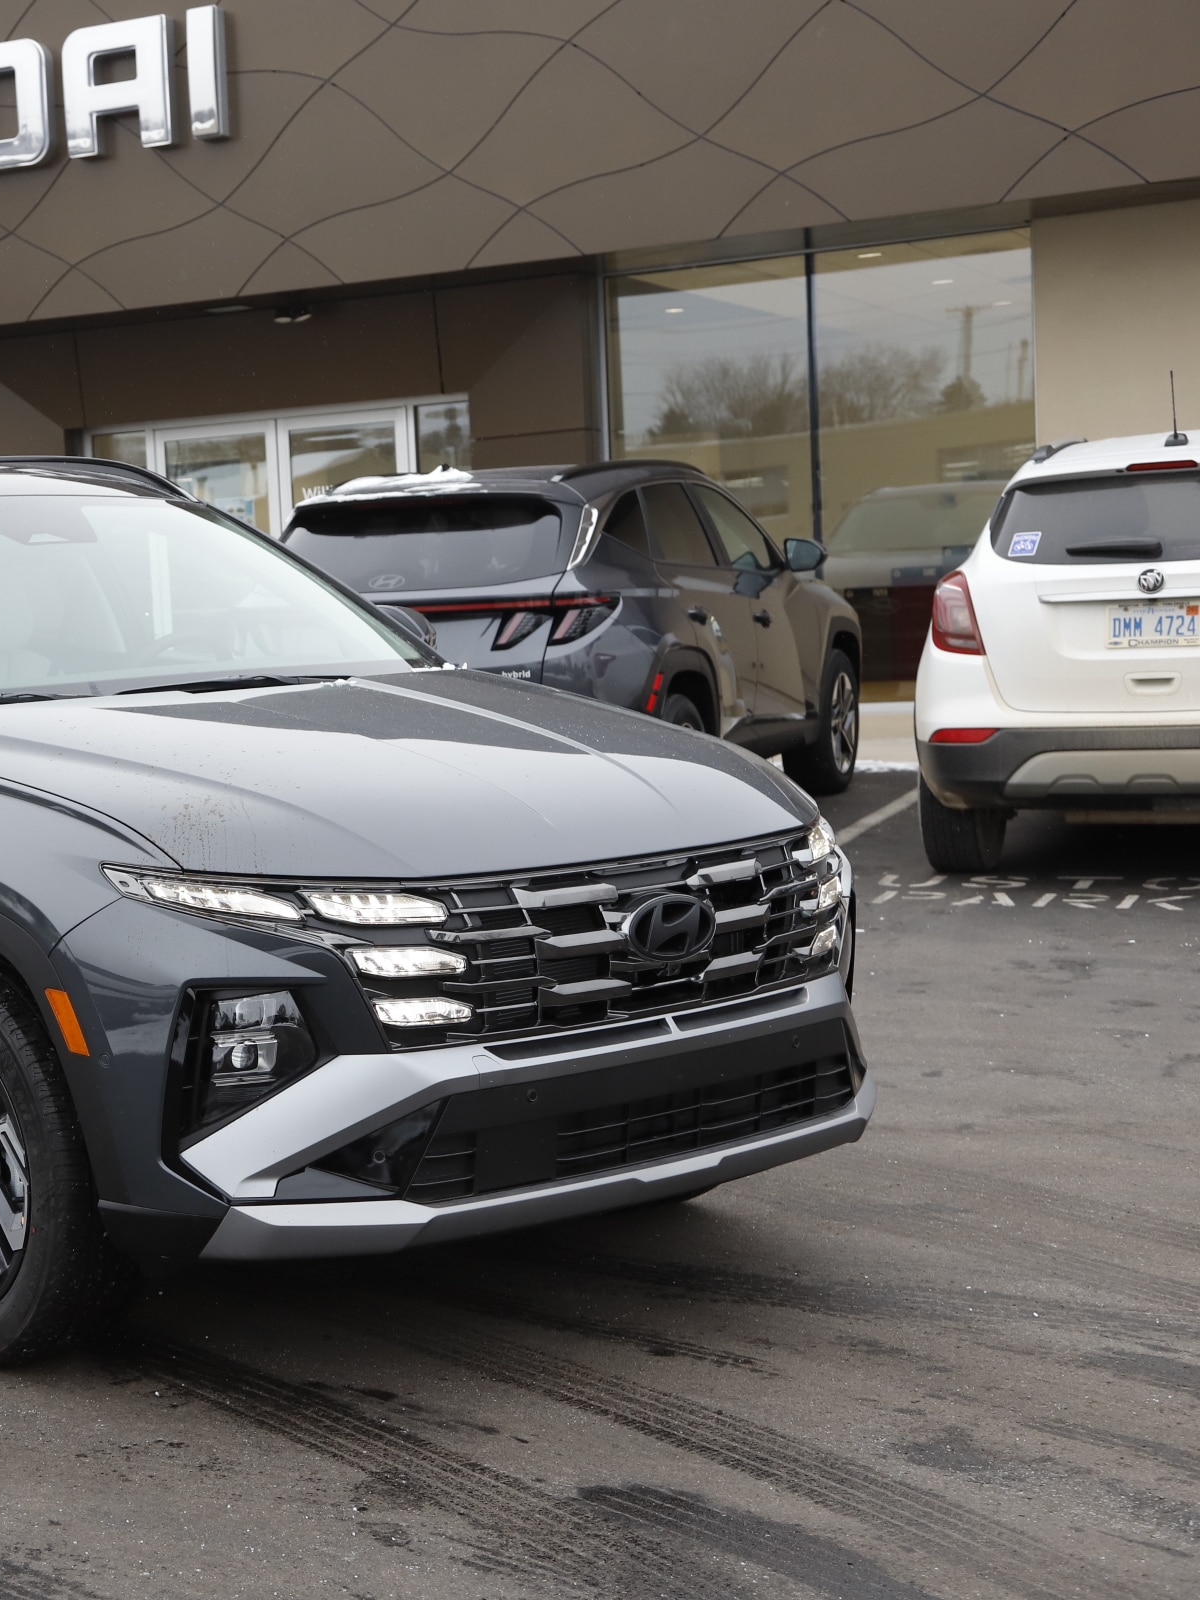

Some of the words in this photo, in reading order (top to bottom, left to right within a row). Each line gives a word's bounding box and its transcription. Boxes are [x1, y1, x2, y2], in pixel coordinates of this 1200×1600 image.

[1112, 616, 1143, 638] DMM
[1154, 614, 1196, 636] 4724
[501, 669, 531, 679] hybrid
[876, 874, 1200, 890] USTO
[871, 890, 1193, 911] PARK
